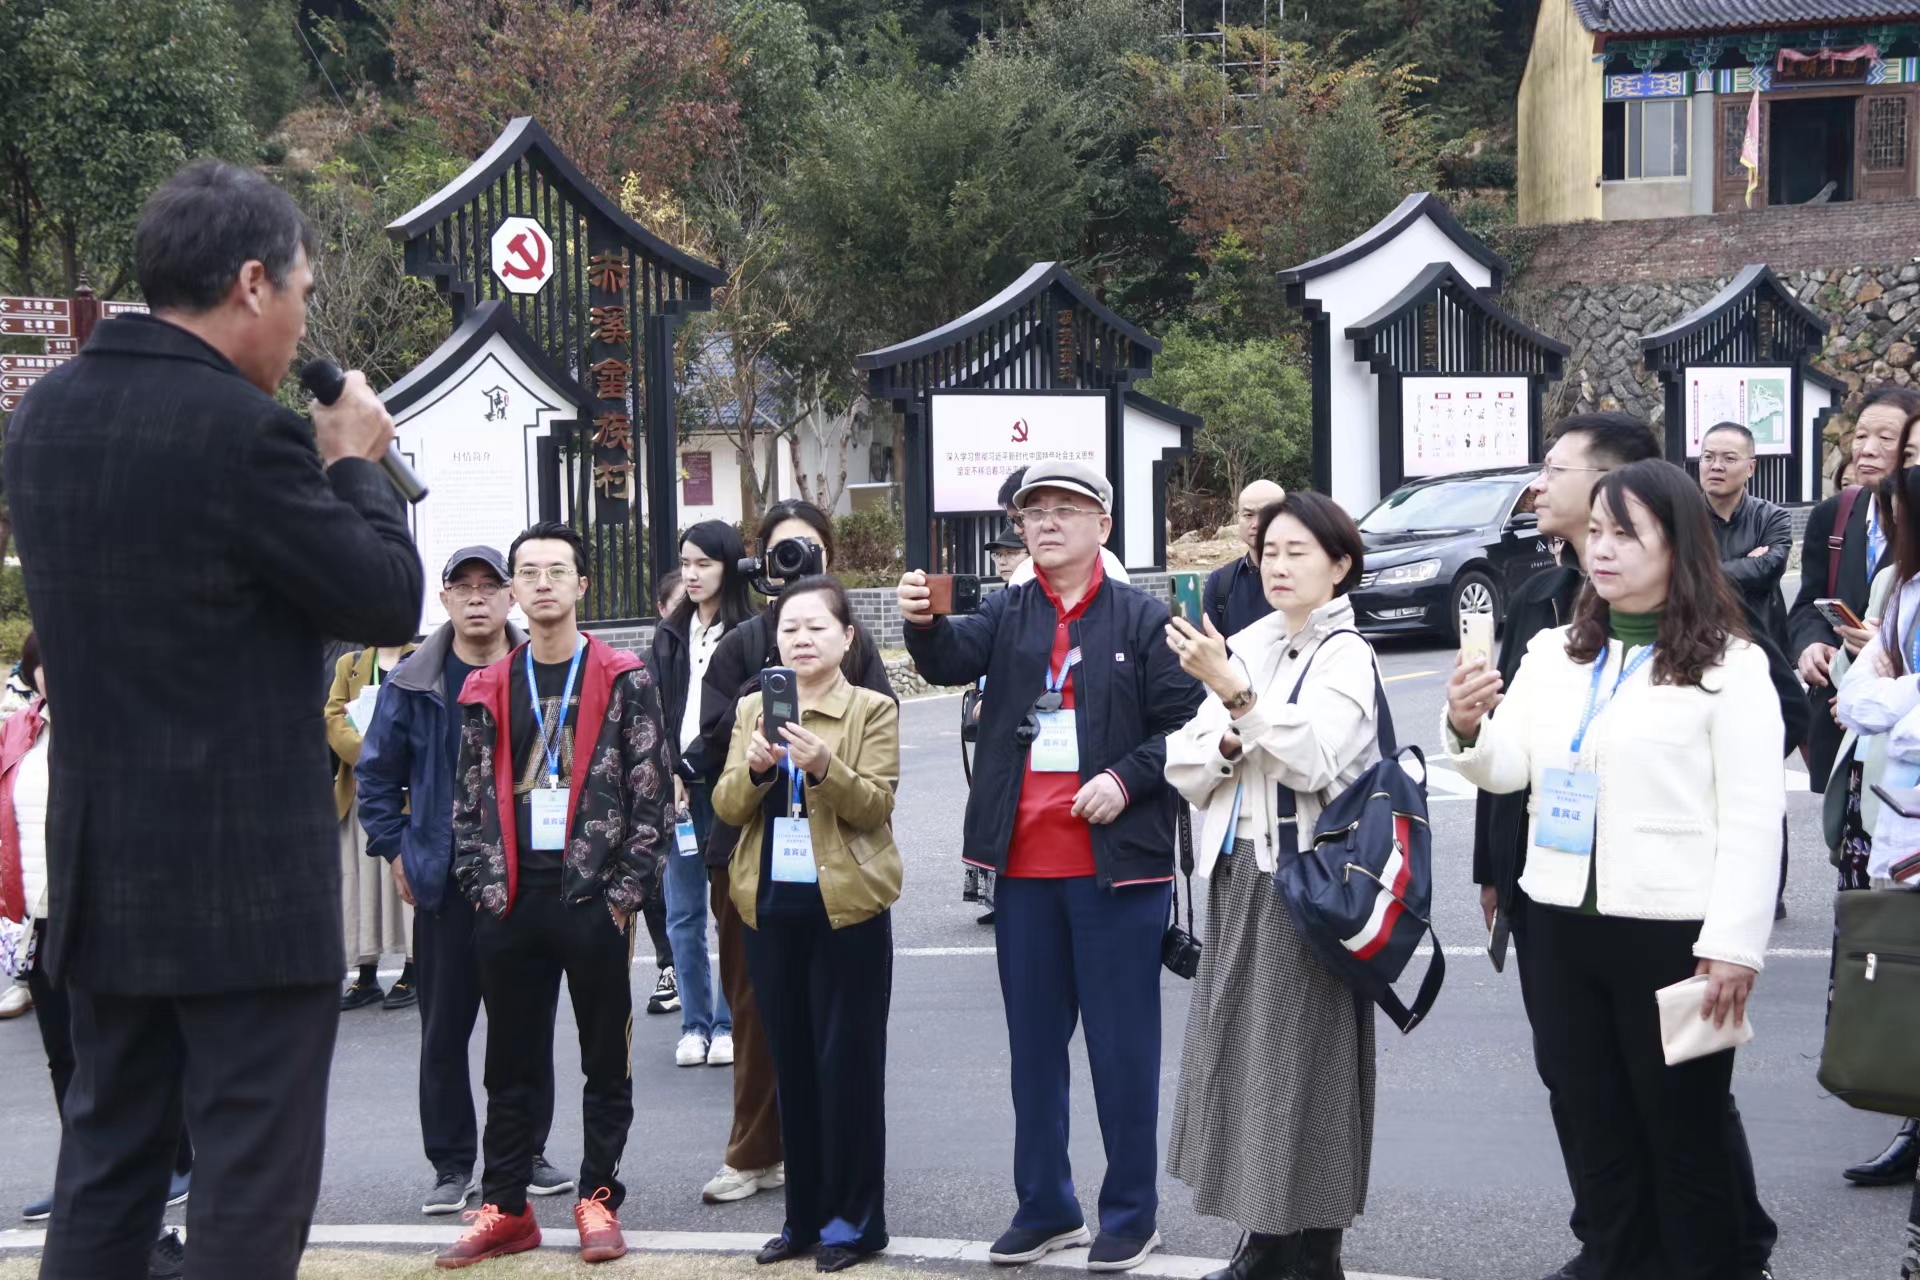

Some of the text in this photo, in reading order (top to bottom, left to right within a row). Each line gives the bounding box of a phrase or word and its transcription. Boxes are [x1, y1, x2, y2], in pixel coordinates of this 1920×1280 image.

[1551, 807, 1581, 821] 嘉宾证
[783, 848, 808, 857] 嘉宾证
